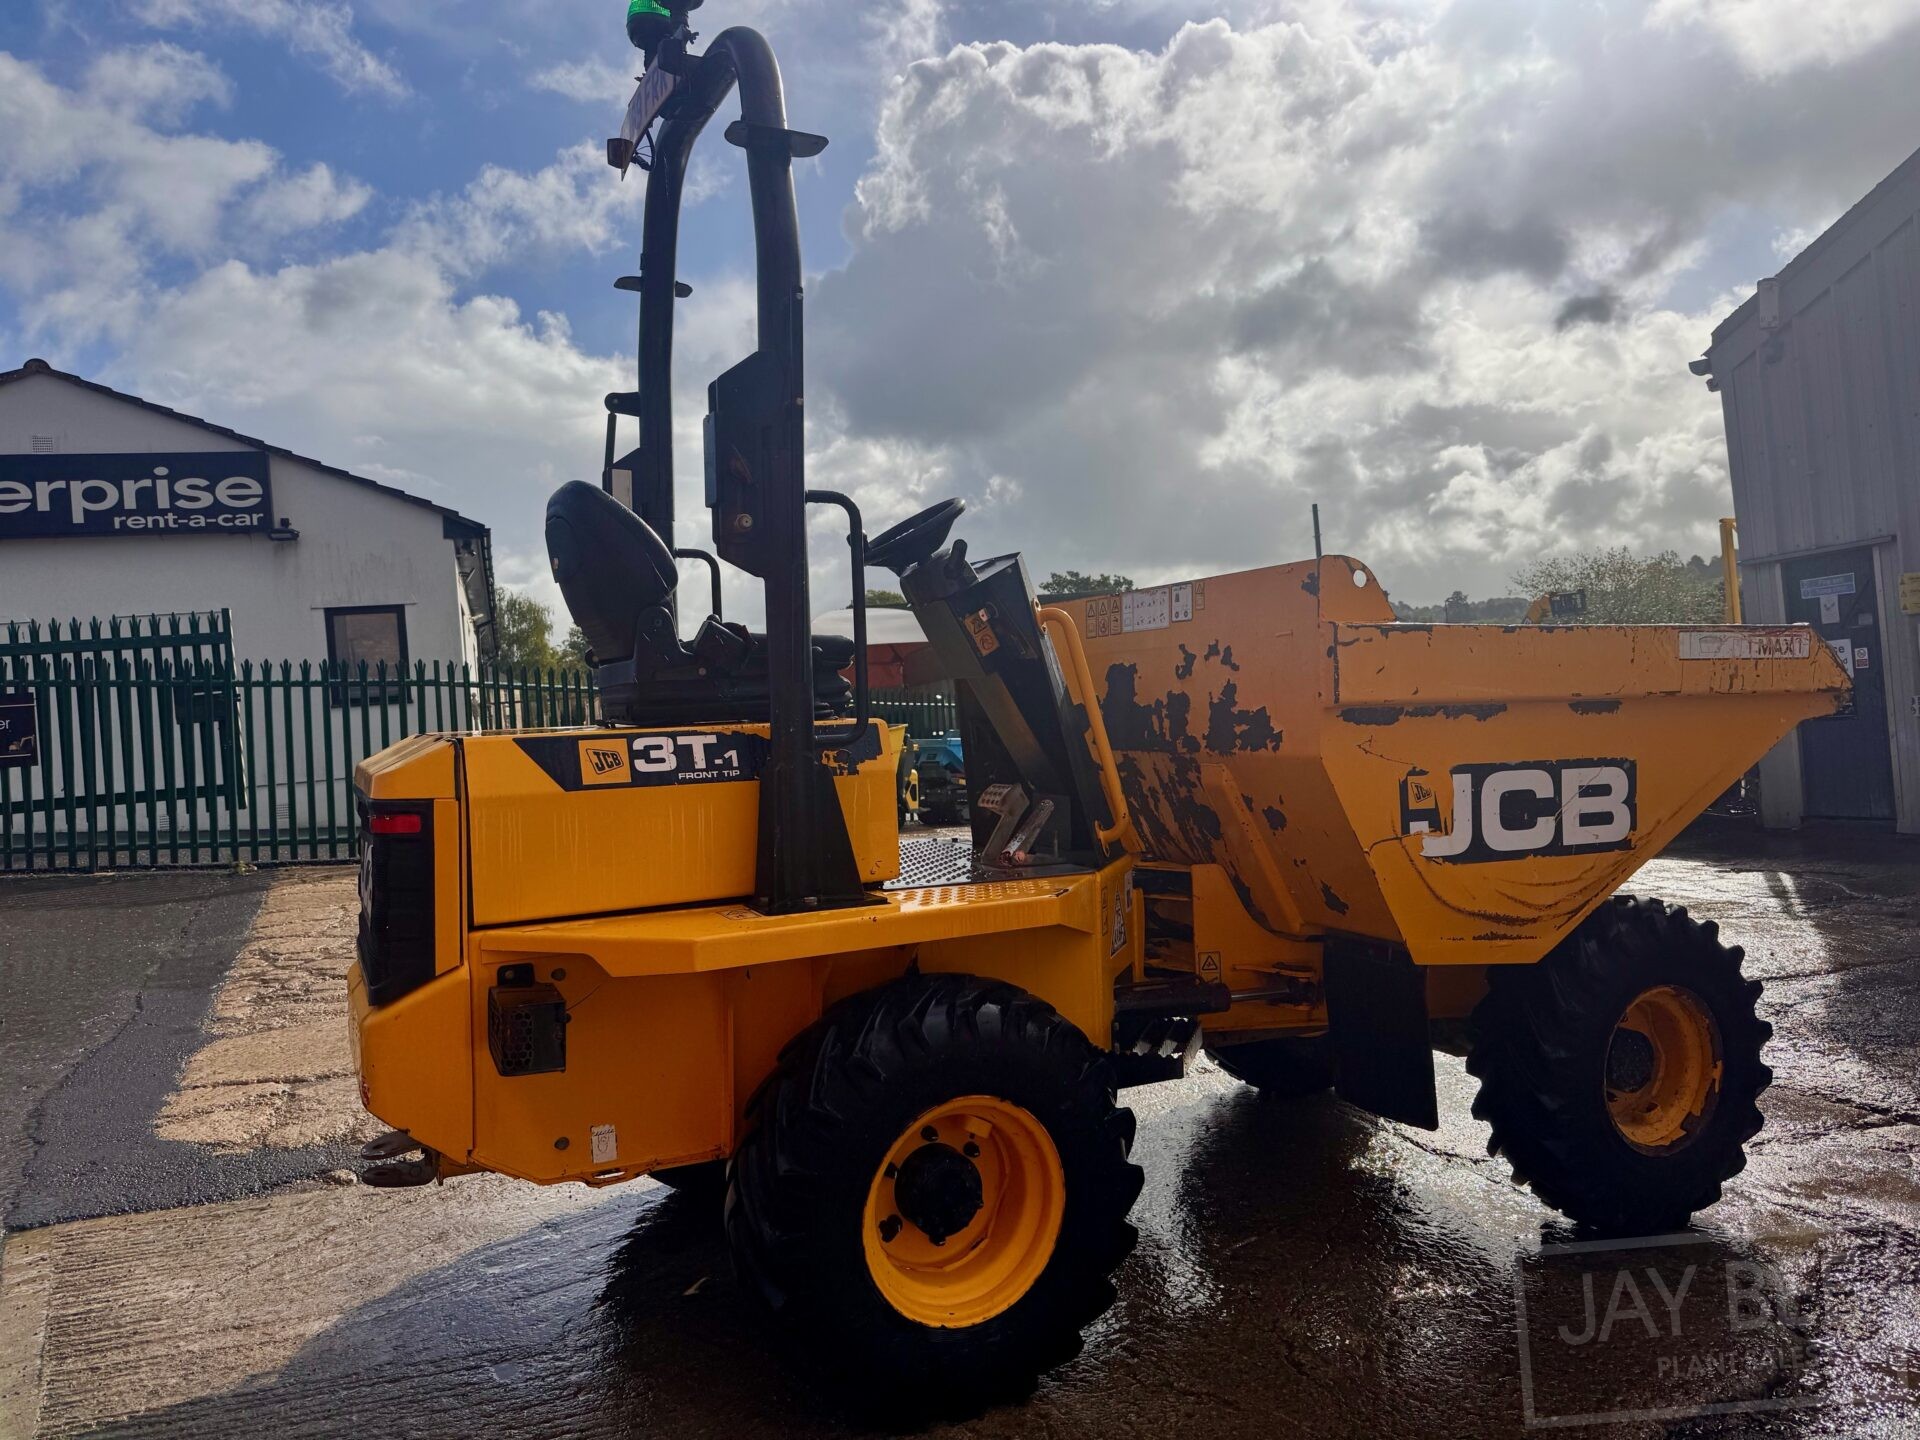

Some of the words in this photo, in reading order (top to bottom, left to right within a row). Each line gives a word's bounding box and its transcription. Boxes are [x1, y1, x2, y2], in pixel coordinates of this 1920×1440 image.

[0, 467, 263, 524] erprise
[113, 511, 264, 530] rent-a-car
[593, 750, 623, 772] JCB
[678, 770, 720, 781] FRONT
[722, 769, 741, 778] TIP
[1410, 766, 1631, 857] JCB
